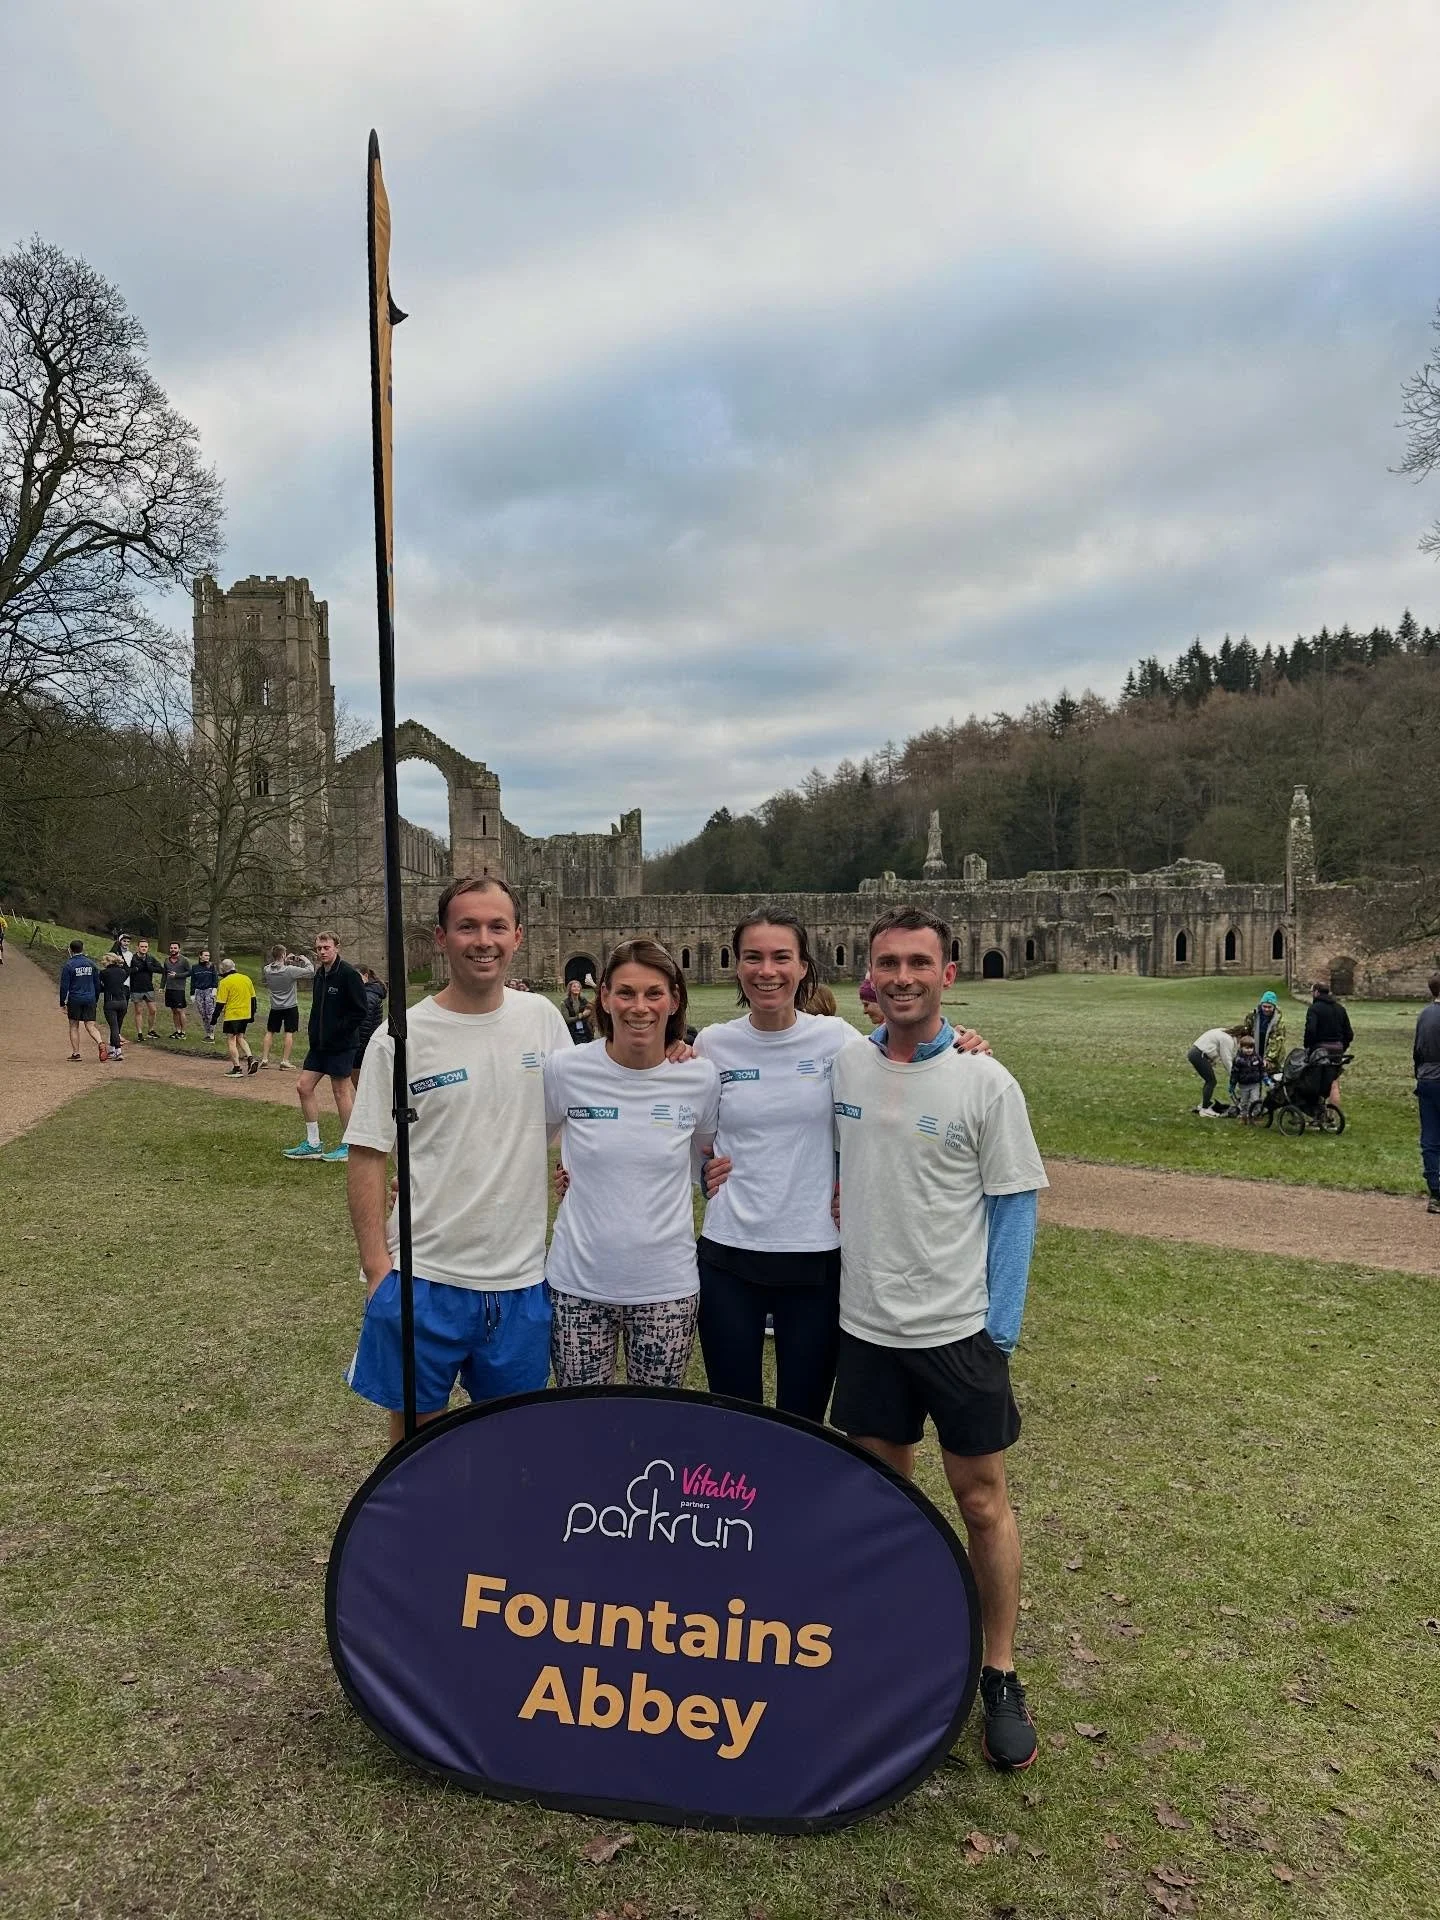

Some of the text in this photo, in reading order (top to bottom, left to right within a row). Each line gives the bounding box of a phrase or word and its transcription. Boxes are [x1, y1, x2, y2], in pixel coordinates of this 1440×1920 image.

[562, 1460, 753, 1551] parkrun
[680, 1500, 710, 1510] partners
[681, 1463, 757, 1510] Vitality
[461, 1573, 832, 1668] Fountains
[517, 1665, 767, 1759] Abbey
